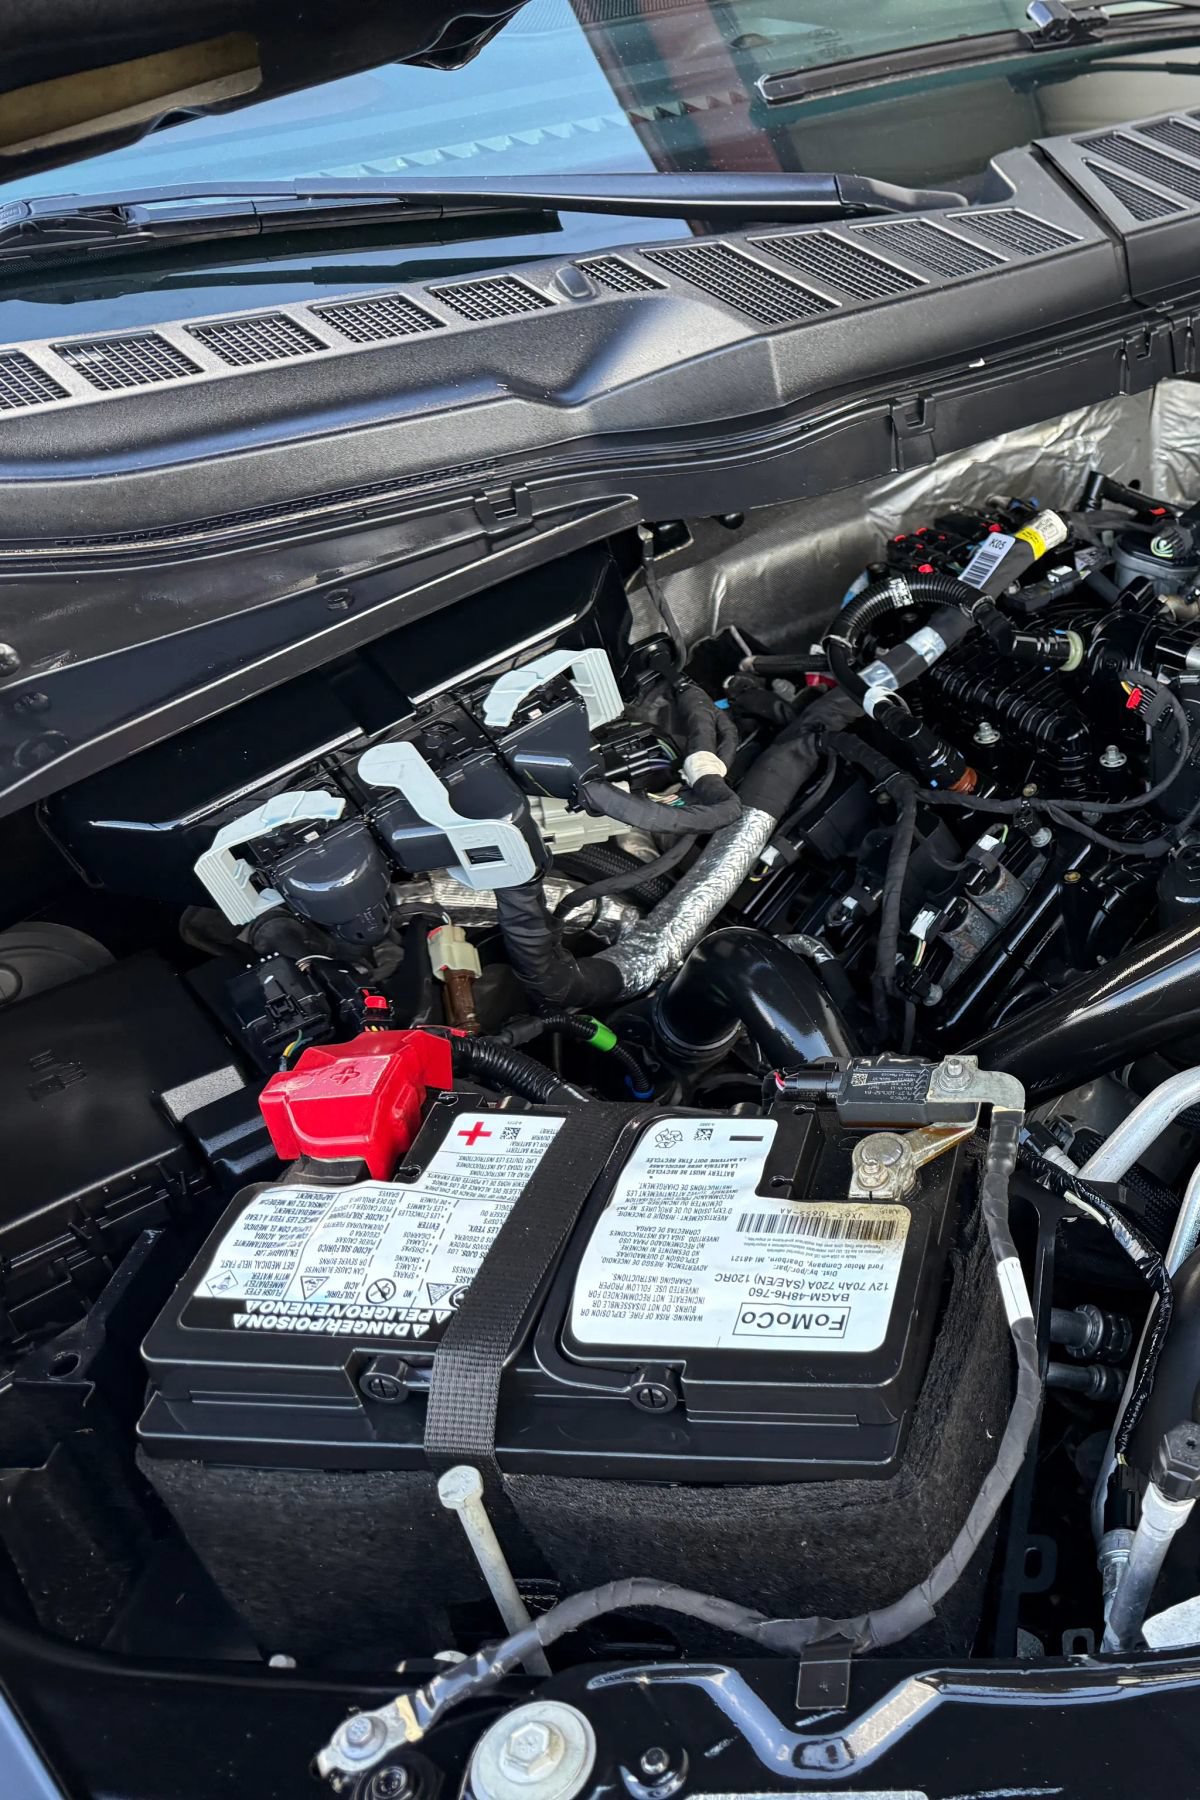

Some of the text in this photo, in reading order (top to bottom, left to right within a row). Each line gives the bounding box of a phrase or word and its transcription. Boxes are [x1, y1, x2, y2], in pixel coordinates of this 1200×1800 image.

[707, 1170, 735, 1178] BATTERY
[486, 1226, 499, 1234] LES
[406, 1238, 428, 1247] FLAMAS
[658, 1248, 690, 1256] DESMONTE
[691, 1248, 700, 1256] NO
[235, 1260, 253, 1269] HELP
[254, 1260, 282, 1270] MEDICAL
[282, 1261, 296, 1270] GET
[395, 1262, 418, 1271] FLAMES
[641, 1260, 664, 1268] RIESGO
[807, 1261, 842, 1270] Company,
[393, 1270, 415, 1279] SPARKS
[660, 1276, 692, 1285] CHARGING
[712, 1272, 888, 1291] 12V 70Ah 720A (SAE/EN) 120RC
[344, 1281, 360, 1290] ACID
[598, 1282, 624, 1290] PROPER
[625, 1283, 652, 1292] FOLLOW
[668, 1286, 700, 1294] INVERTED
[403, 1290, 413, 1298] NO
[588, 1290, 601, 1298] FOR
[602, 1291, 650, 1302] RECOMMENDED
[650, 1294, 665, 1302] NOT
[748, 1288, 850, 1302] BAGM-48H6-760
[592, 1300, 602, 1308] OR
[603, 1300, 646, 1311] DISASSEMBLE
[647, 1303, 660, 1312] NOT
[662, 1304, 671, 1312] DO
[255, 1301, 433, 1321] PELIGRO/VENENO
[580, 1308, 590, 1316] OR
[590, 1310, 626, 1318] EXPLOSION
[644, 1312, 654, 1320] OF
[672, 1314, 703, 1322] WARNING:
[246, 1314, 411, 1336] DANGER/POISON
[740, 1312, 846, 1330] FoMoCo
